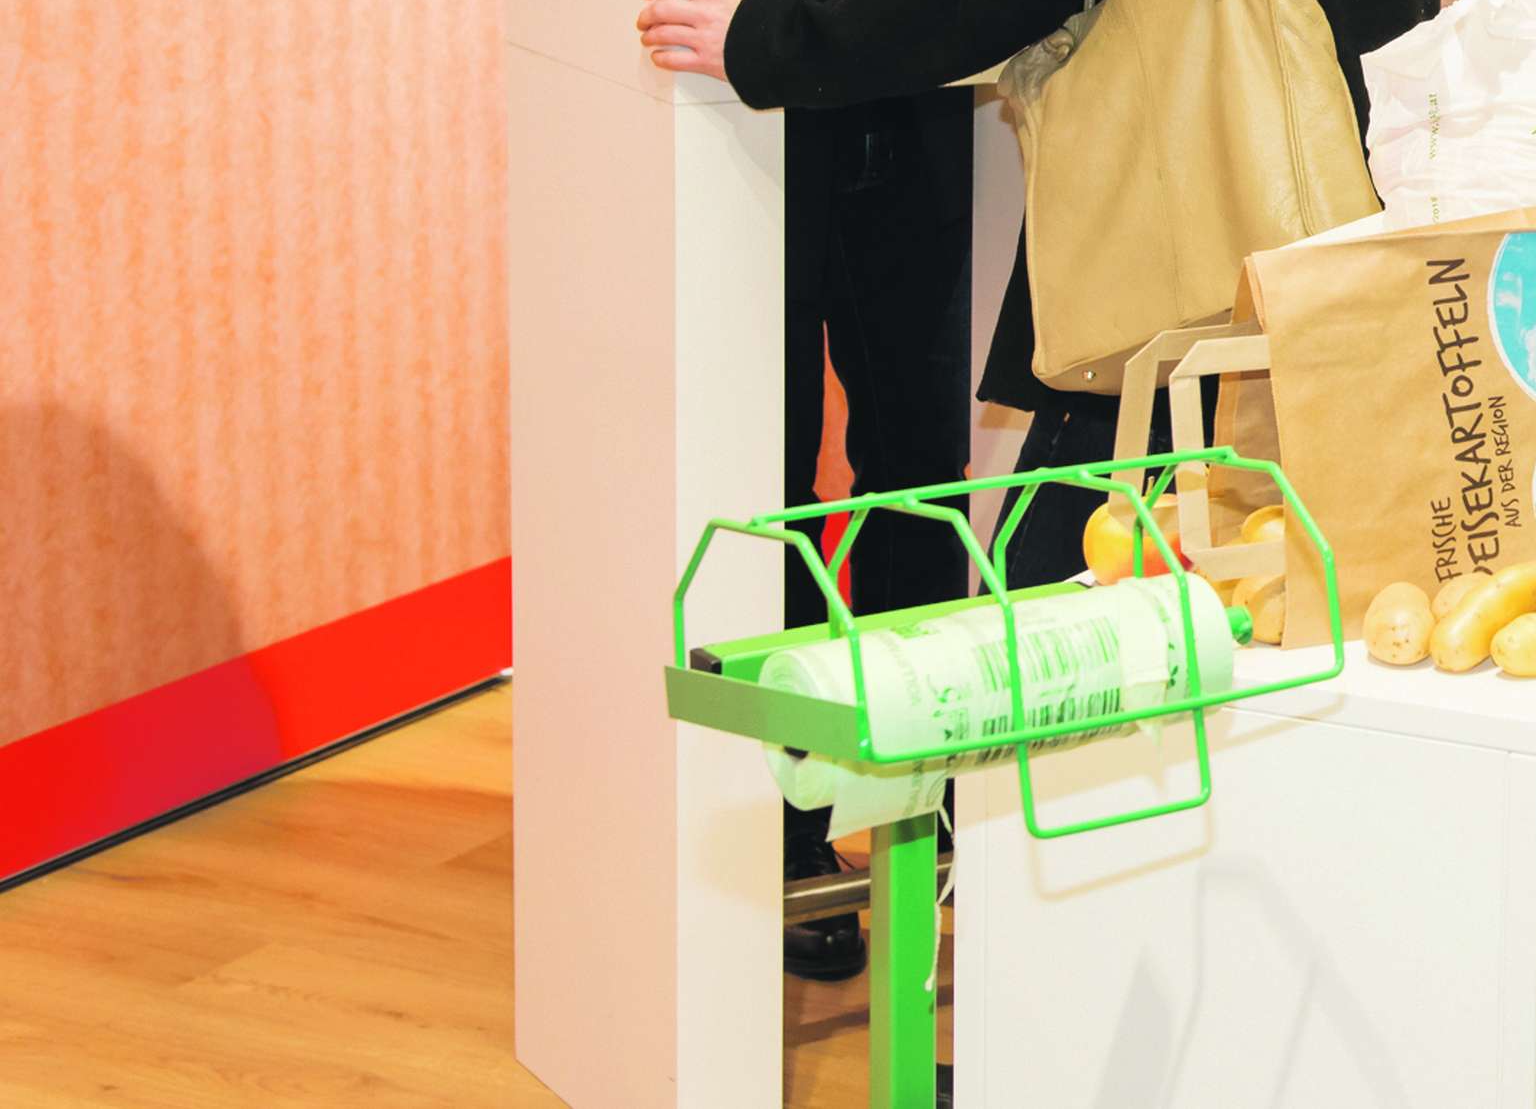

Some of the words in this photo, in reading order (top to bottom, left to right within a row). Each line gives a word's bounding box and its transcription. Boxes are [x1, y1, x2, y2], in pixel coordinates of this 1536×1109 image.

[1425, 257, 1501, 576] EISEKARTOFFELN
[1487, 395, 1512, 458] REGION
[1498, 457, 1522, 494] DER
[1430, 496, 1463, 584] FRISCHE
[1501, 498, 1522, 528] AUS
